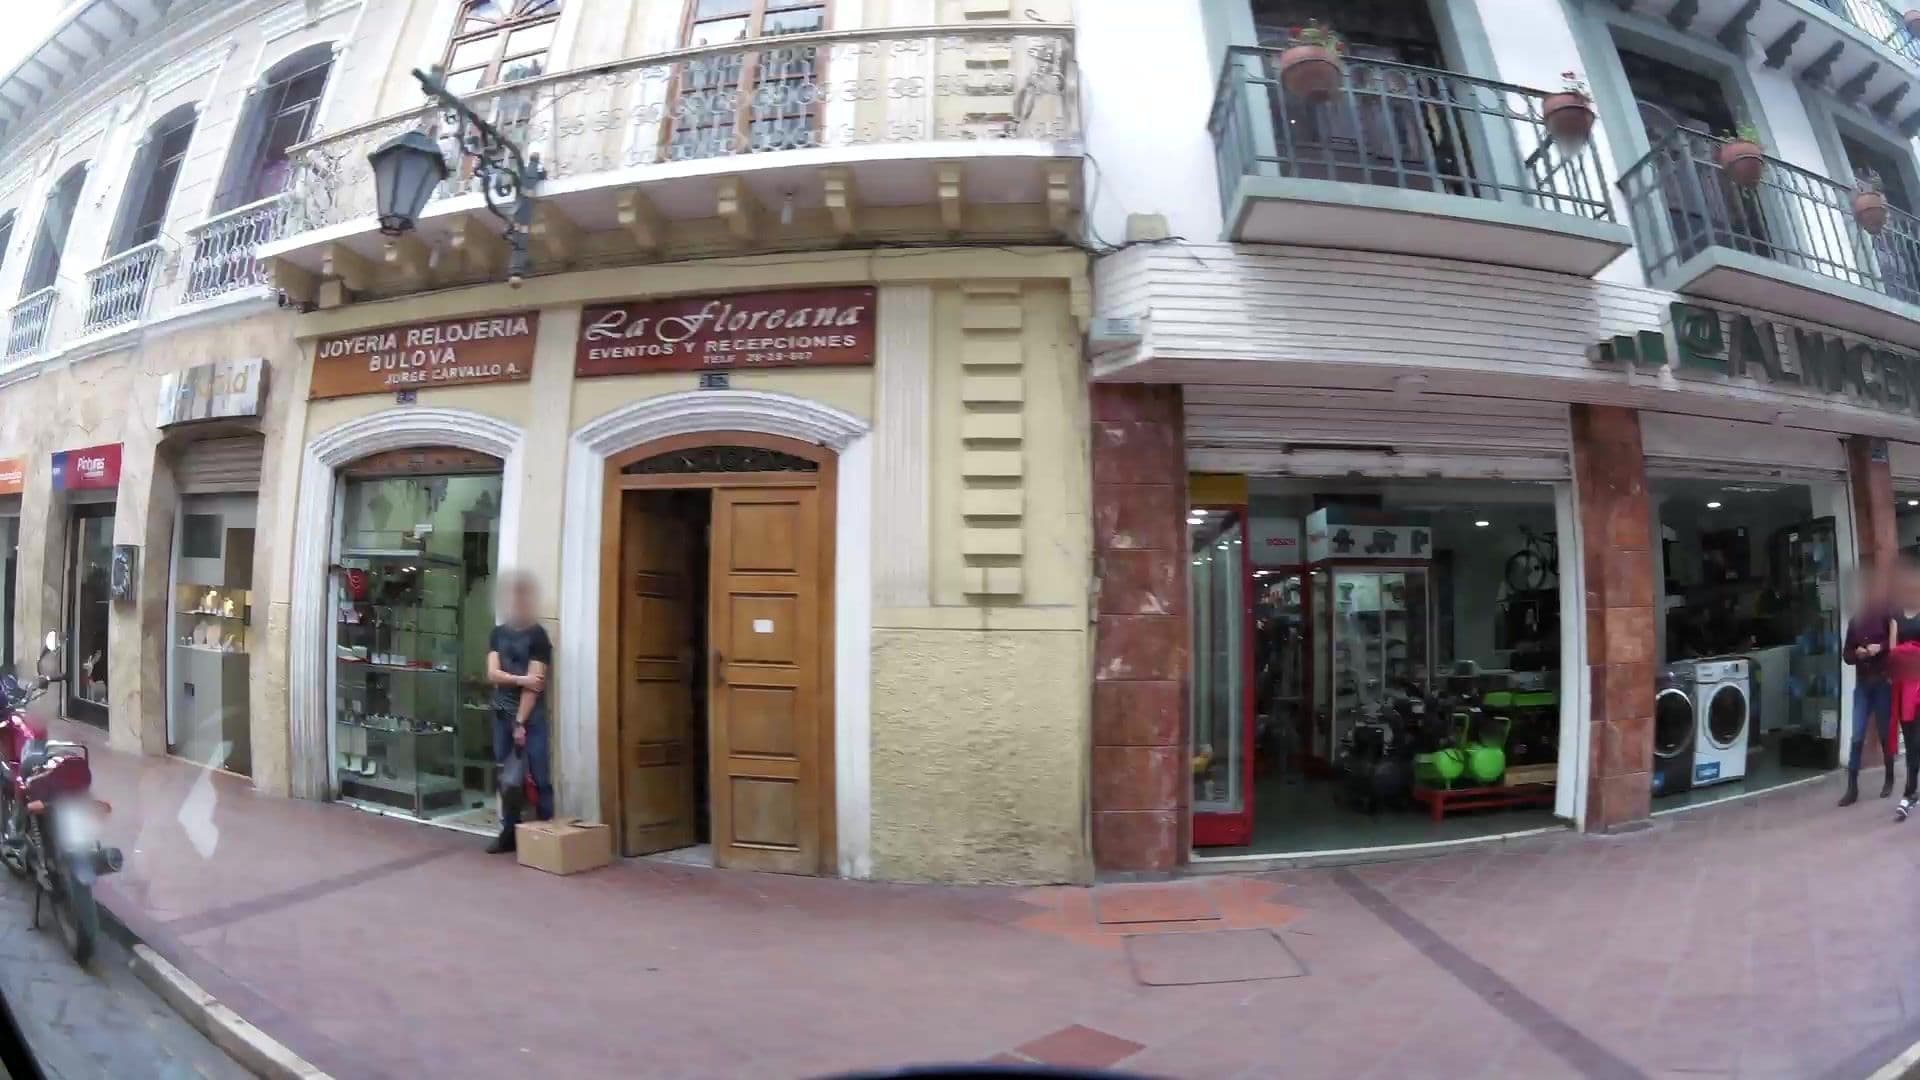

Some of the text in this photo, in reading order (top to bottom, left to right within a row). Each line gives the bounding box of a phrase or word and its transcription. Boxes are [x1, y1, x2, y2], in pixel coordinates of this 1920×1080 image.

[585, 300, 865, 343] La Floreana
[320, 317, 529, 359] JOYERIA RELOJERIA
[588, 334, 857, 361] EVENTOS Y RECEPCIONES
[369, 347, 457, 372] BULOVA
[431, 364, 501, 380] CARVALLO
